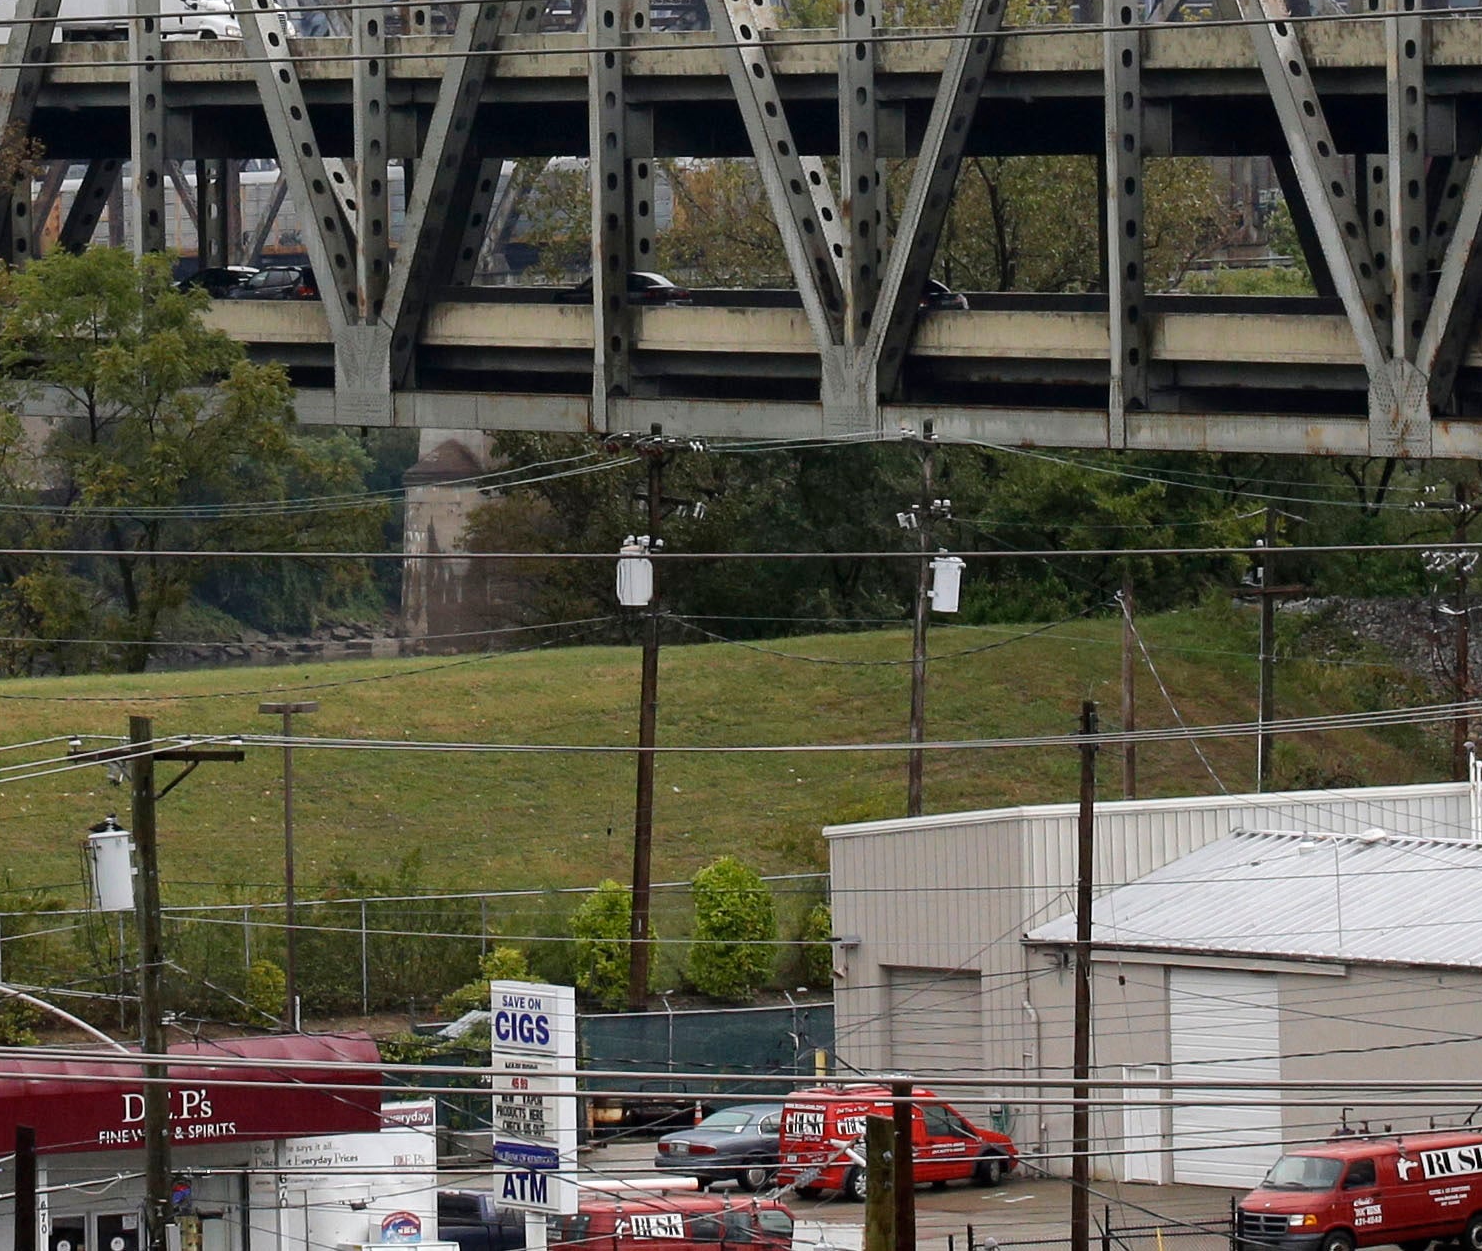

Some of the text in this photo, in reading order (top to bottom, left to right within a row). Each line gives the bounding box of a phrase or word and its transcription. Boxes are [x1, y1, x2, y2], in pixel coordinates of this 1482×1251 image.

[502, 994, 542, 1011] SAVE ON
[495, 1010, 550, 1046] CIGS
[98, 1129, 130, 1145] FINE
[174, 1125, 185, 1140] &
[188, 1121, 237, 1139] SPIRITS
[334, 1152, 359, 1164] Prices
[502, 1172, 548, 1204] ATM
